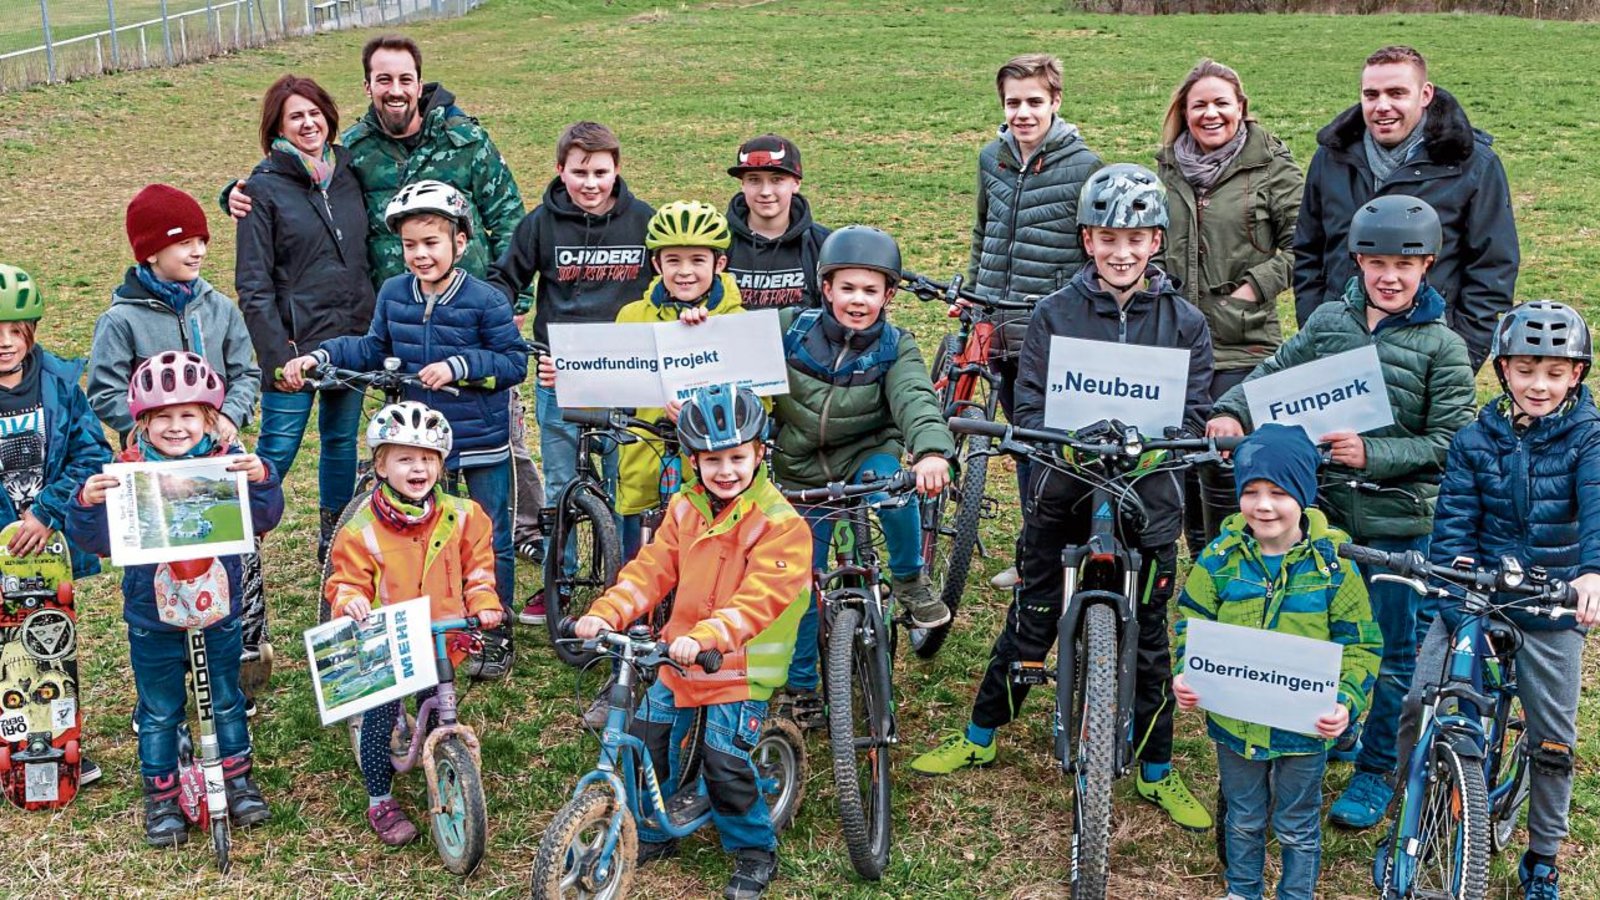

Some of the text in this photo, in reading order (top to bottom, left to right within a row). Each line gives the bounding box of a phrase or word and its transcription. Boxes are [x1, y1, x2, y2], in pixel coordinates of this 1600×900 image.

[555, 350, 719, 373] Crowdfunding Projekt
[1269, 379, 1371, 421] Funpark
[394, 609, 415, 679] MEHR
[191, 630, 213, 722] HUDOR
